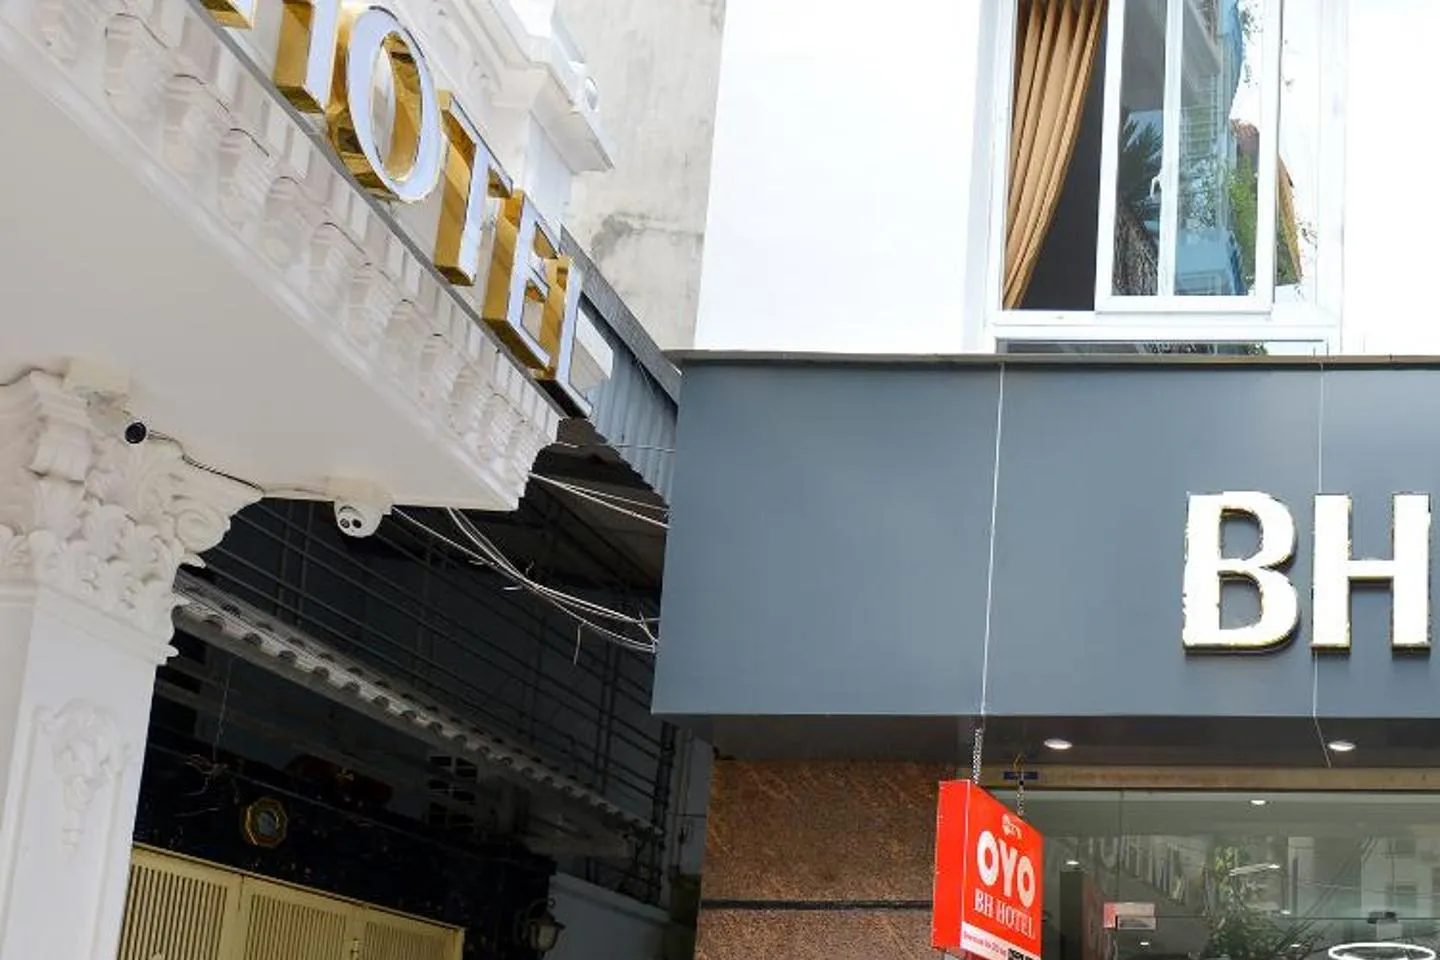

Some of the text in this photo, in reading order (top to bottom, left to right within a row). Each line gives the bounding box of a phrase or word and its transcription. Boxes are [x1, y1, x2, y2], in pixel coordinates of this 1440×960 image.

[1183, 490, 1432, 655] BH
[976, 830, 1036, 908] OYO
[974, 887, 1036, 940] BH HOTEL
